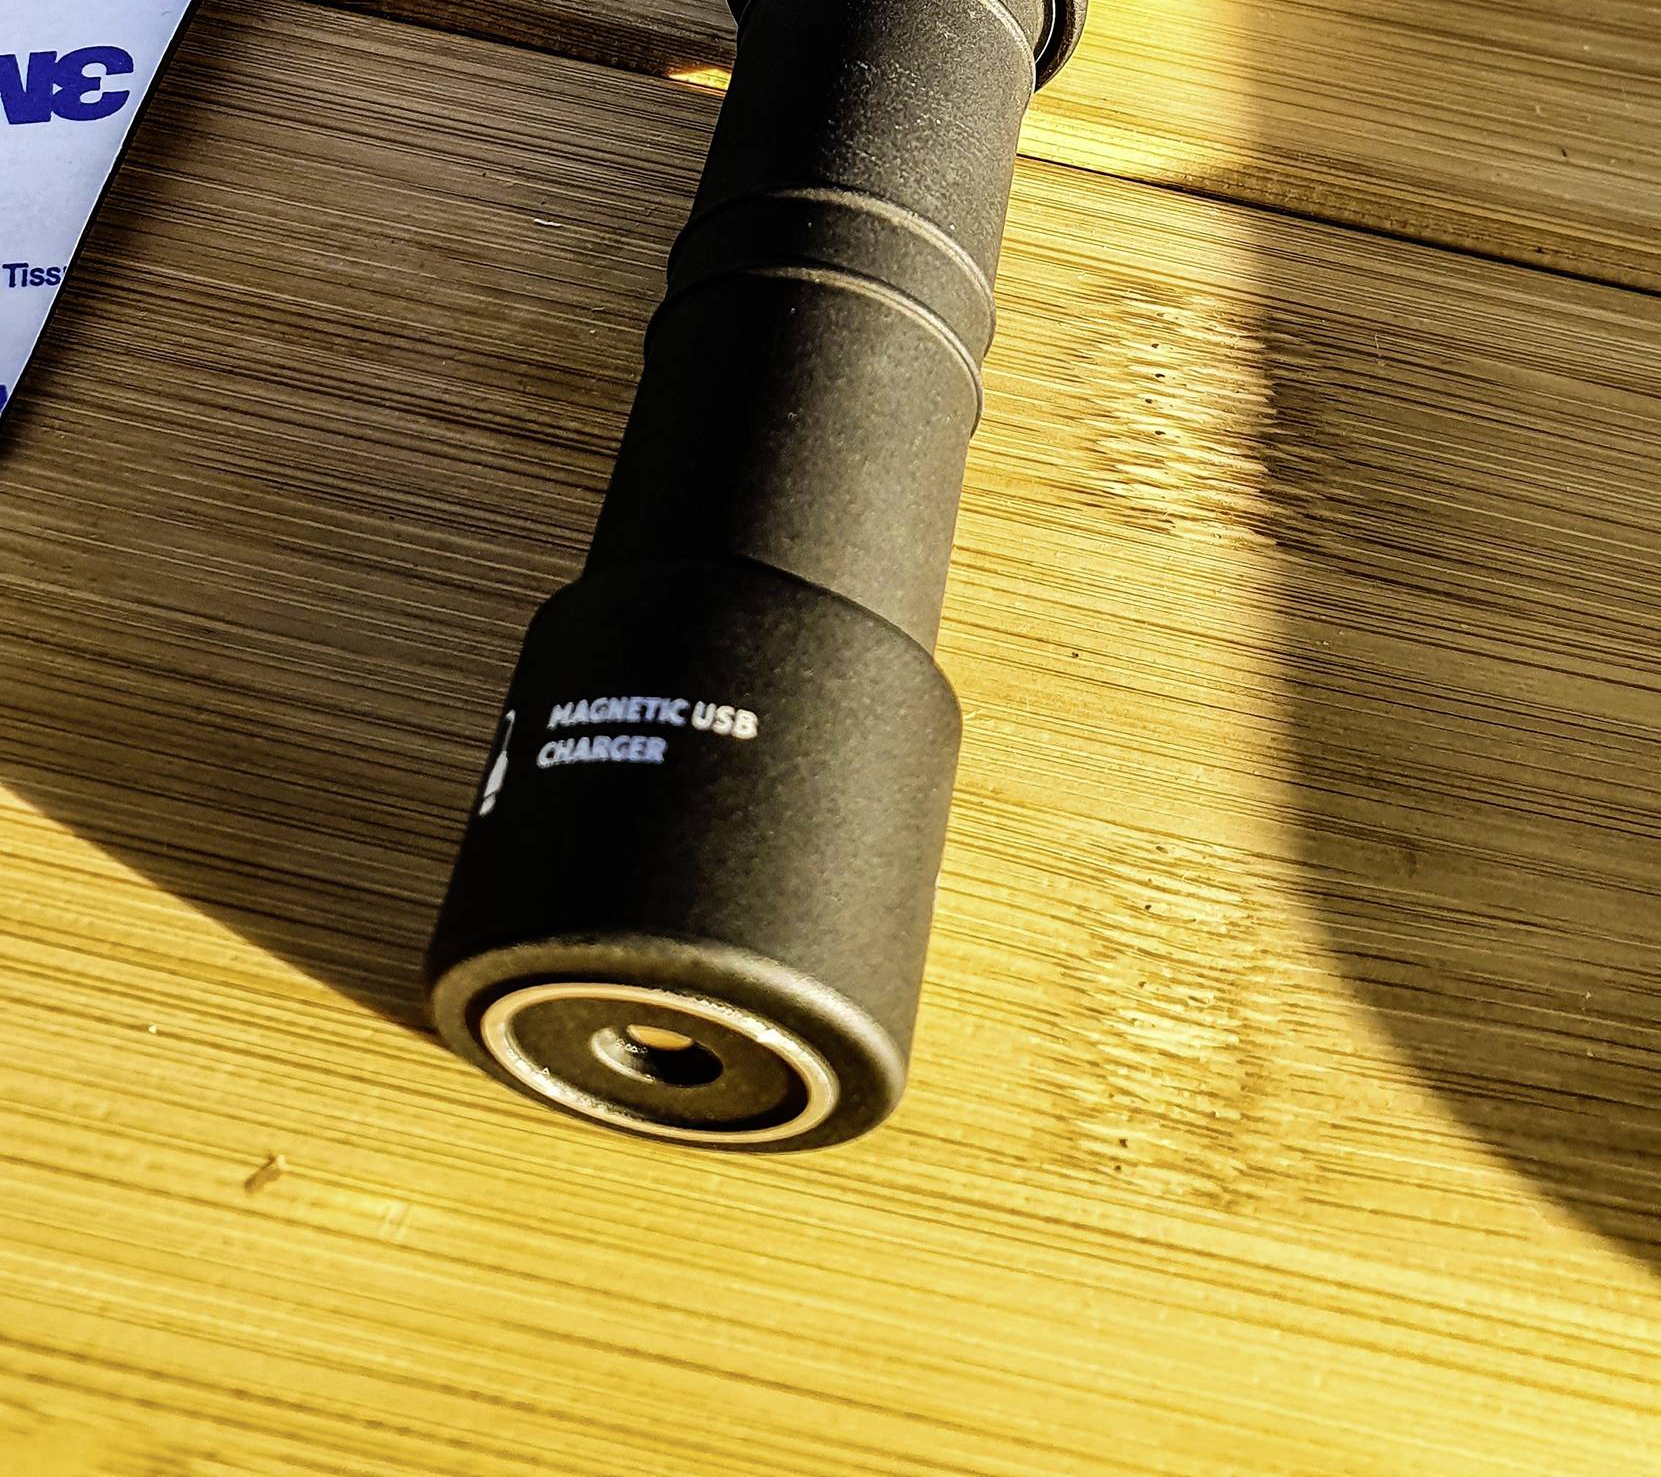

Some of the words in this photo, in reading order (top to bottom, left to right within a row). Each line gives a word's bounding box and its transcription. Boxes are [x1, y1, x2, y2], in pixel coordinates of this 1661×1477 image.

[2, 262, 67, 288] Tiss
[547, 696, 690, 730] MAGNETIC
[691, 700, 759, 740] USB
[536, 735, 668, 768] CHARGER
